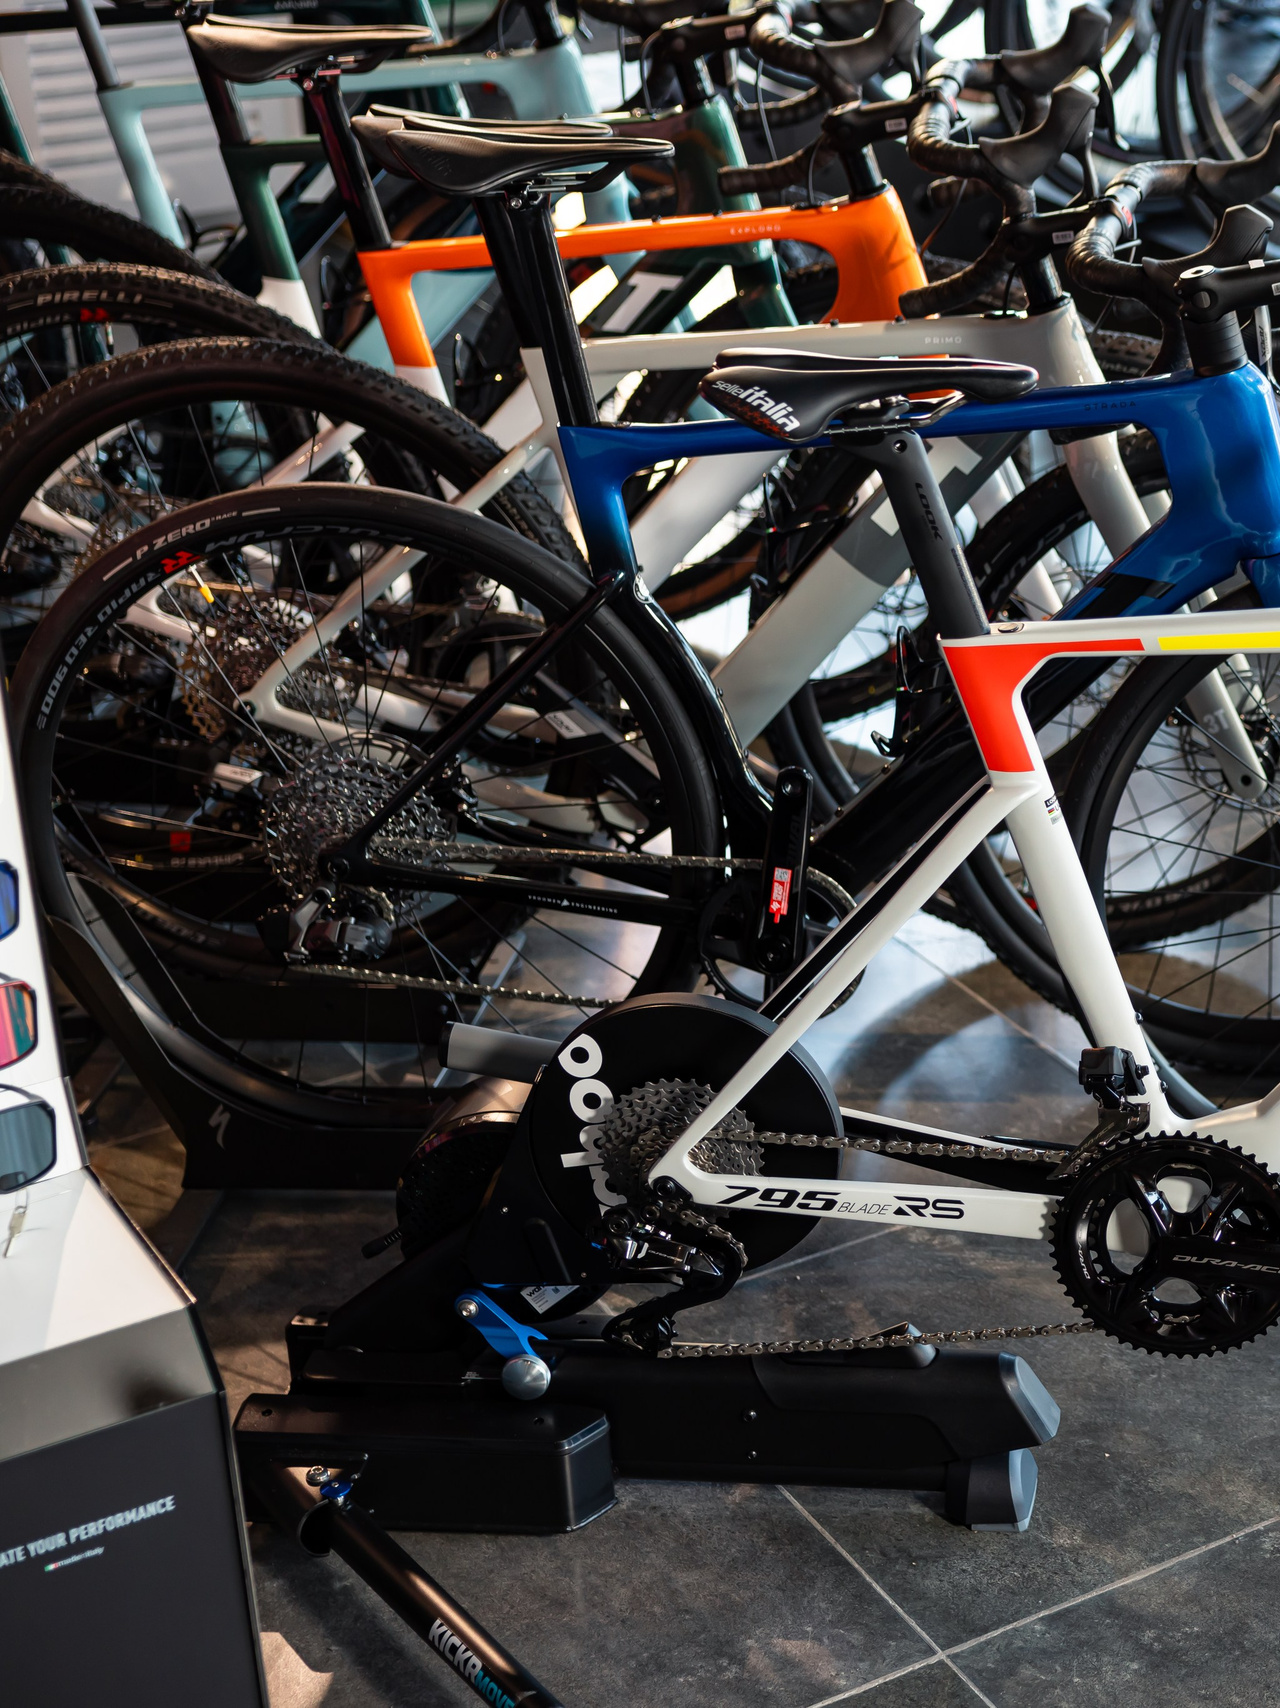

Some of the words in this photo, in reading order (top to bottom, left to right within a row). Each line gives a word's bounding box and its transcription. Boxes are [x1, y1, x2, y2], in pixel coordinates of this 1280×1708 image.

[36, 289, 143, 307] PIRELLI
[924, 336, 963, 345] PRIMO
[711, 380, 745, 397] selle
[739, 386, 801, 432] italia
[1084, 401, 1137, 412] STRADA
[152, 517, 211, 550] ZERO
[215, 511, 238, 521] RACE
[914, 482, 944, 541] LOOK
[64, 624, 98, 666] RED
[40, 664, 68, 716] 900
[1203, 709, 1229, 733] 3T
[571, 902, 618, 914] ENGINEERING
[716, 1184, 841, 1212] 795
[836, 1201, 893, 1215] BLADE
[893, 1195, 965, 1220] RS
[27, 1531, 68, 1558] YOUR
[68, 1495, 176, 1545] PERFORMANCE
[428, 1617, 482, 1684] KICKR
